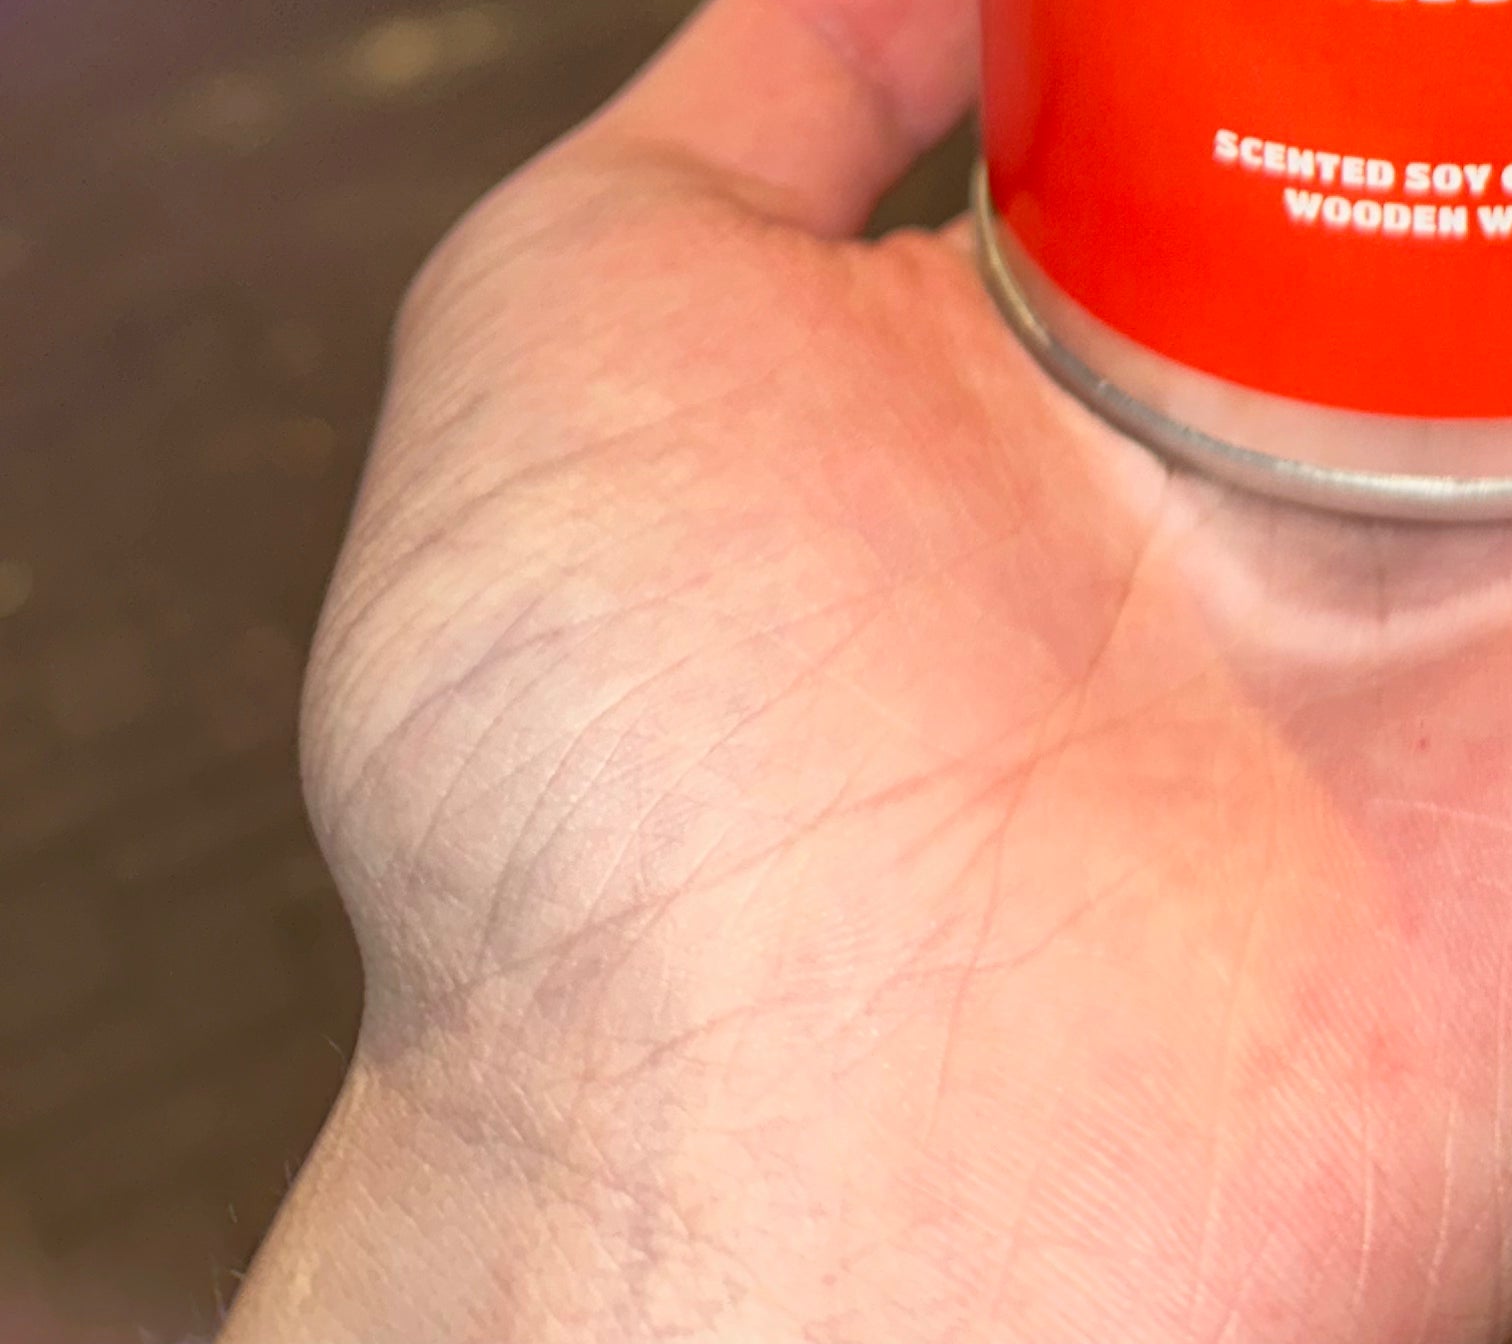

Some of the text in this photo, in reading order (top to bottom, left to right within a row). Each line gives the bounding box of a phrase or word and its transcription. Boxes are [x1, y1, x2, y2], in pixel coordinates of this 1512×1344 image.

[1213, 128, 1396, 191] SCENTED
[1402, 161, 1493, 196] SOY
[1282, 186, 1469, 239] WOODEN
